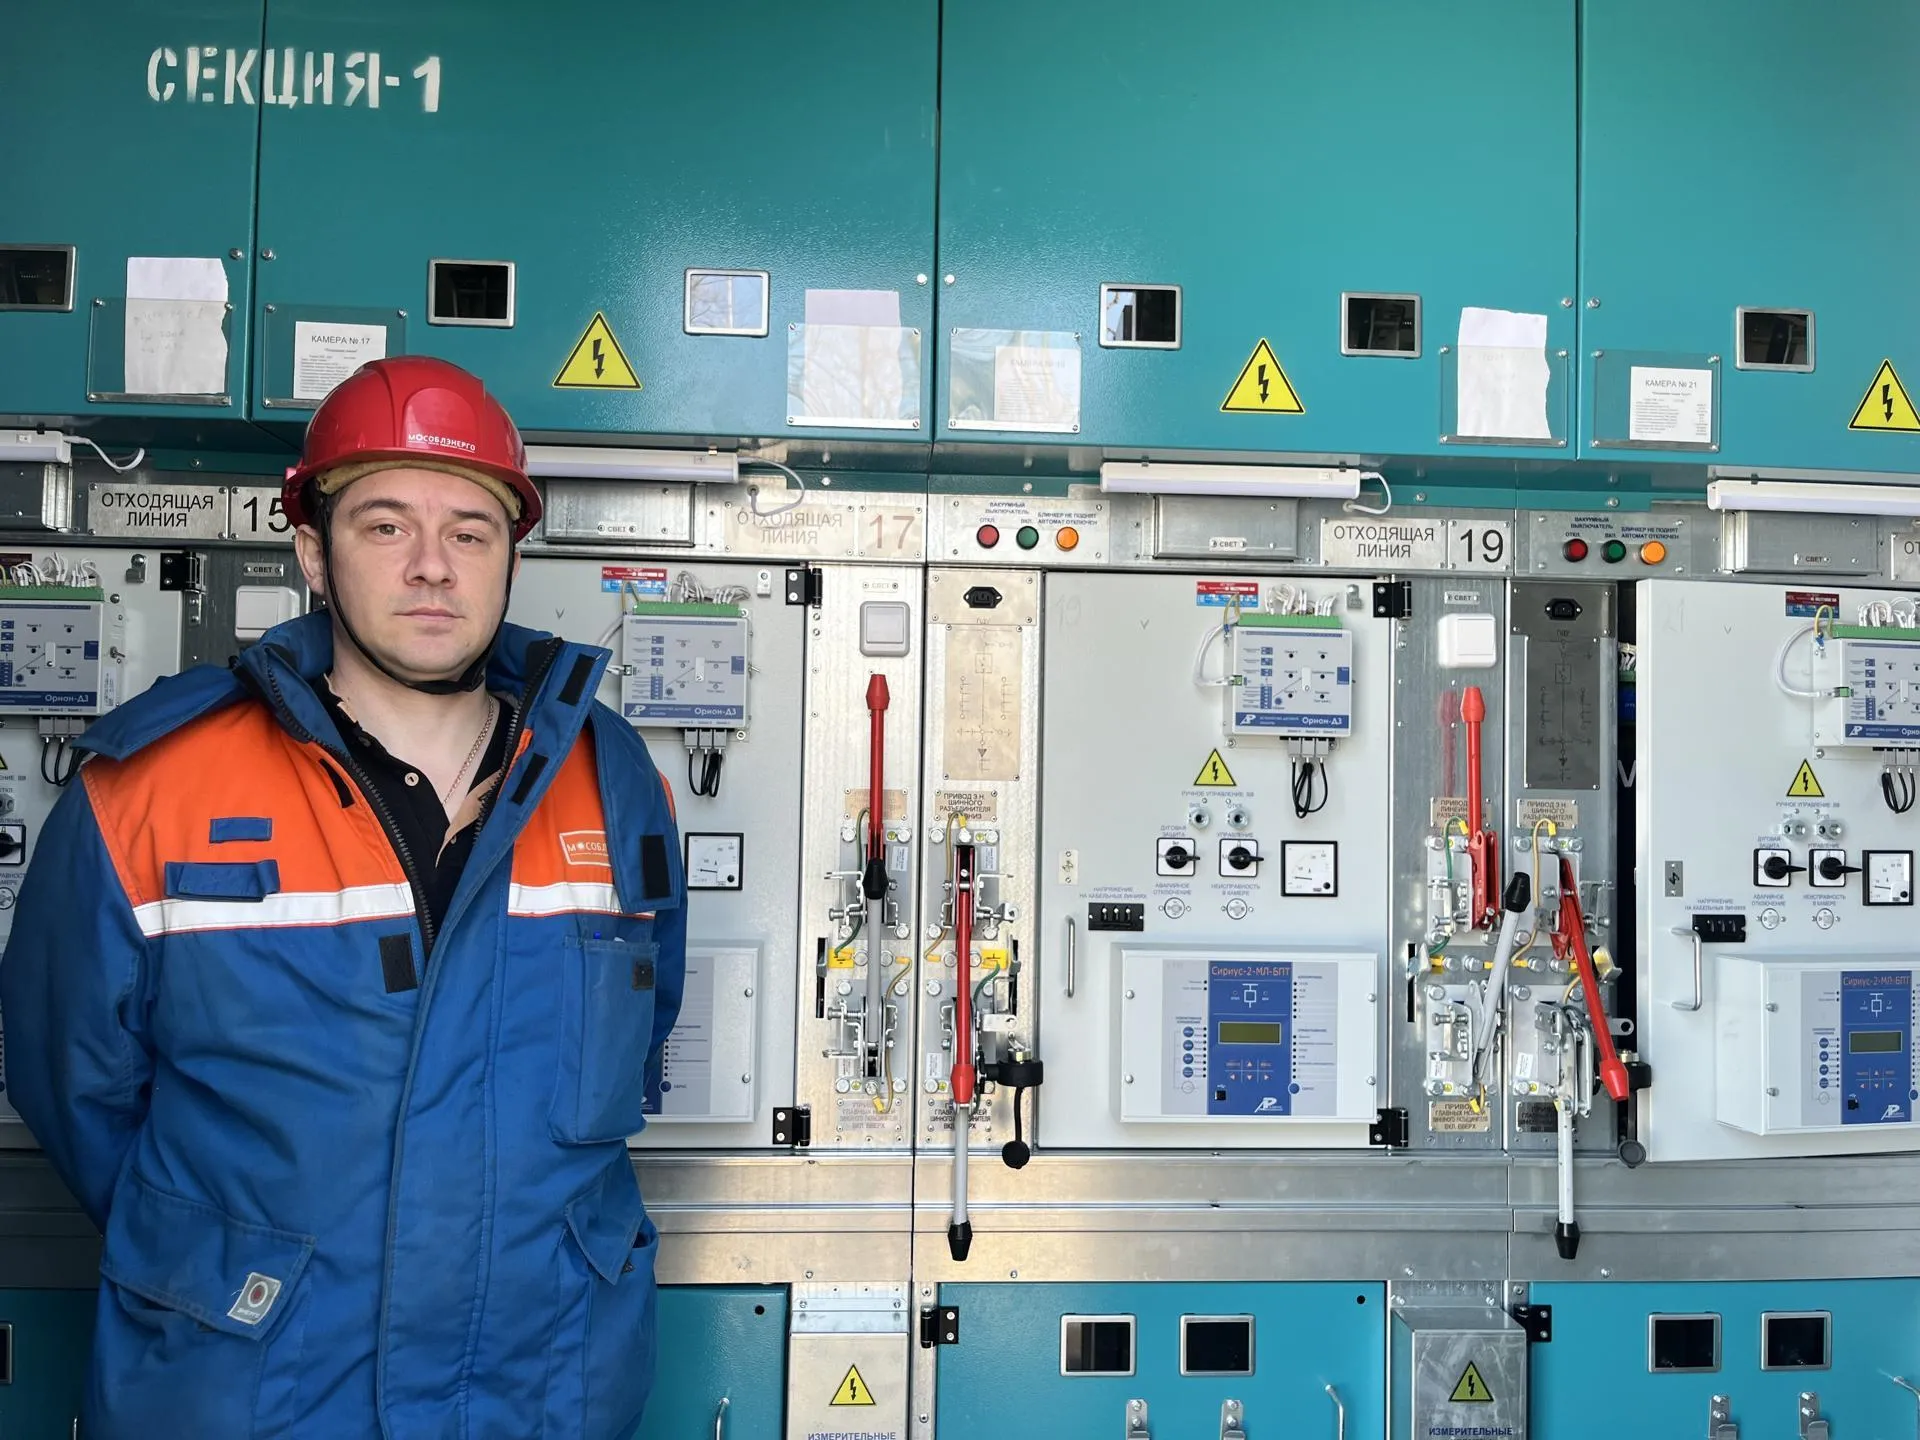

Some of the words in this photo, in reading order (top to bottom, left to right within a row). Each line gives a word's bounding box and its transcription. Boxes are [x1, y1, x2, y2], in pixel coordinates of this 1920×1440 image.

[311, 335, 347, 345] КАМЕРА
[361, 337, 371, 345] 17
[1645, 380, 1677, 388] КАМЕРА
[1688, 381, 1697, 389] 21
[408, 434, 476, 452] МОСОБЛЭНЕРГО
[101, 492, 213, 512] ОТХОДЯЩАЯ
[126, 511, 187, 528] ЛИНИЯ
[243, 496, 292, 533] 15
[737, 511, 842, 530] ОТХОДЯЩАЯ
[607, 525, 627, 534] СВЕТ
[762, 529, 818, 545] ЛИНИЯ
[870, 515, 916, 551] 17
[1333, 525, 1434, 543] ОТХОДЯЩАЯ
[1219, 540, 1238, 548] СВЕТ
[1357, 544, 1411, 559] ЛИНИЯ
[1460, 529, 1504, 564] 19
[253, 566, 272, 574] СВЕТ
[939, 805, 991, 813] РАЗЪЕДИНИТЕЛЯ
[807, 1432, 897, 1440] ИЗМЕРИТЕЛЬНЫЕ
[1429, 1427, 1513, 1436] ИЗМЕРИТЕЛЬНЫЕ
